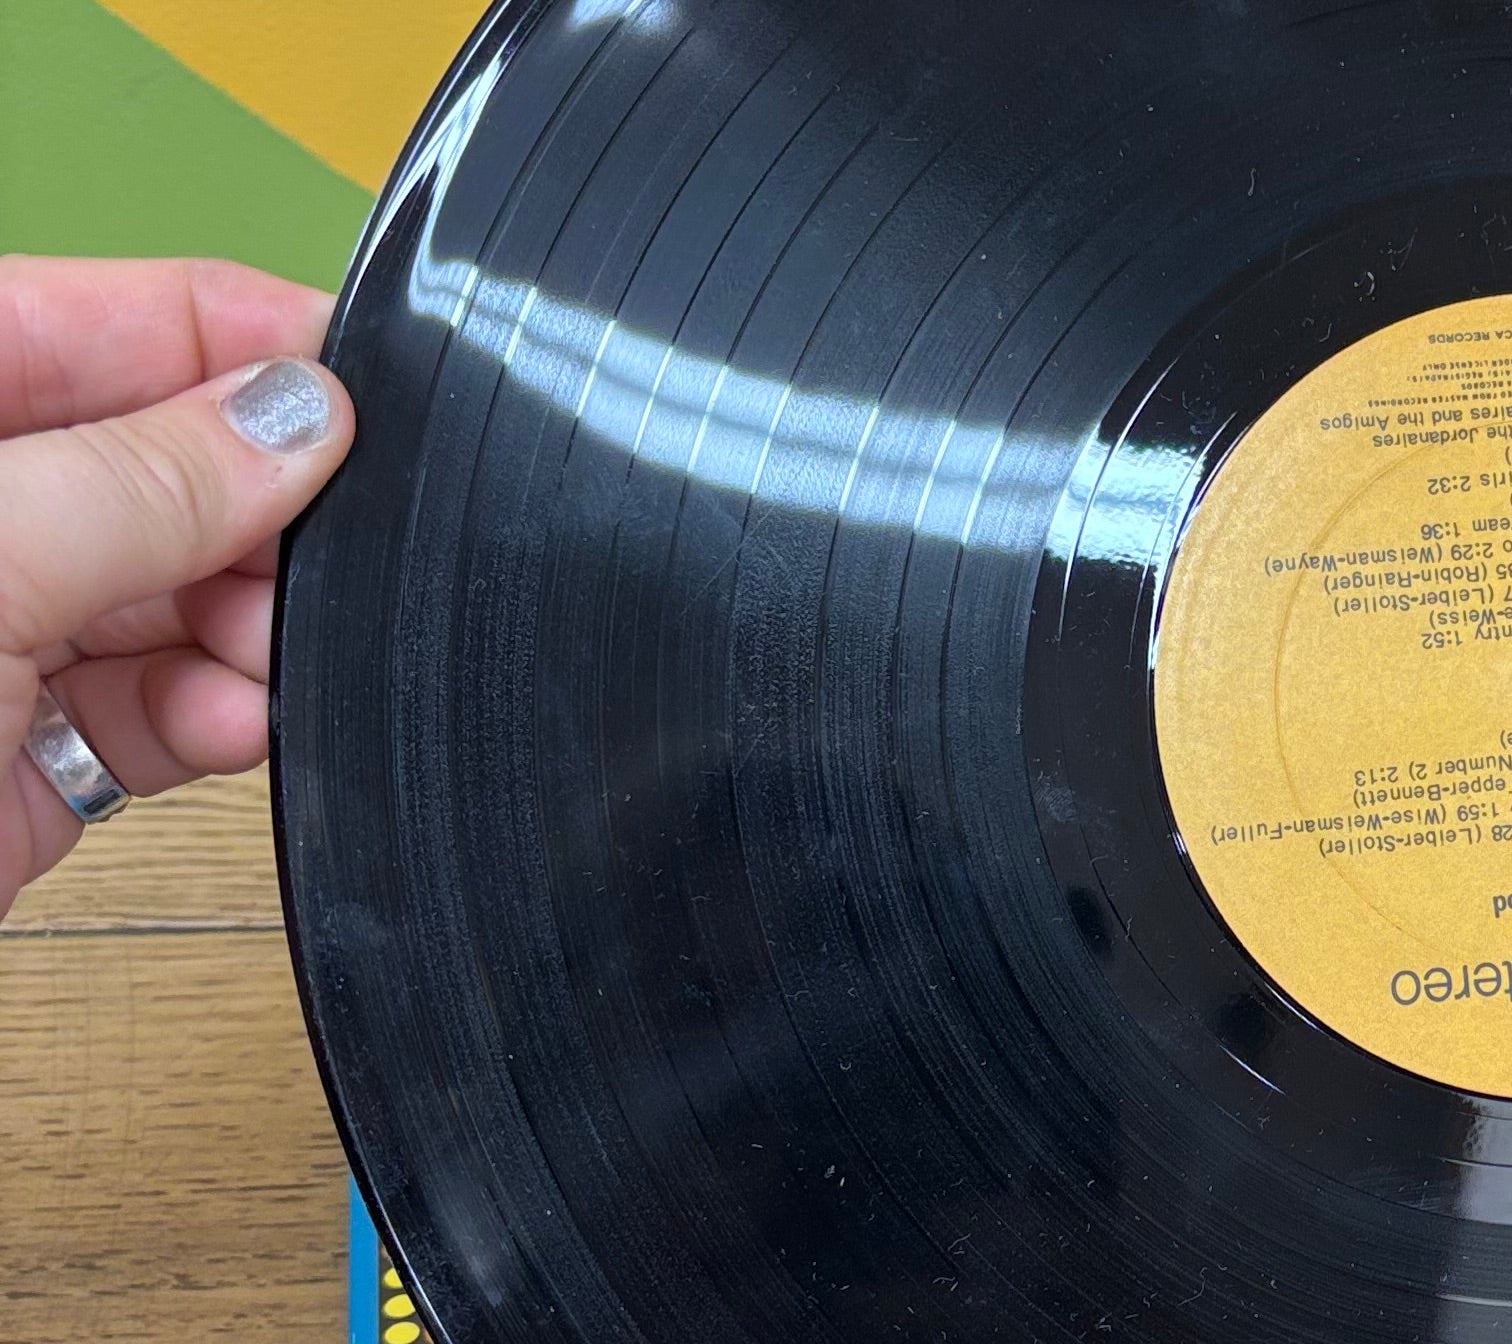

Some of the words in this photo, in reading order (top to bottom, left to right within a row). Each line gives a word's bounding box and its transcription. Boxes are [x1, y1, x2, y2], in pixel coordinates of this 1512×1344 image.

[1320, 413, 1390, 431] Amigos
[1397, 411, 1424, 427] the
[1432, 409, 1463, 426] and
[1372, 427, 1479, 448] Jordanaires
[1427, 475, 1471, 495] 2:32
[1420, 522, 1461, 541] 1:36
[1265, 542, 1442, 577] (Weisman-Wayne)
[1450, 542, 1493, 561] 2:29
[1324, 562, 1487, 595] (Robin-Rainger)
[1334, 583, 1494, 617] (Leiber-Stoller)
[1421, 630, 1463, 650] 1:52
[1354, 766, 1399, 787] 2:13
[1409, 761, 1427, 781] 2)
[1457, 802, 1499, 822] 1:59
[1211, 803, 1446, 846] (Wise-Weisman-Fuller)
[1319, 823, 1482, 859] (Leiber-Stoller)
